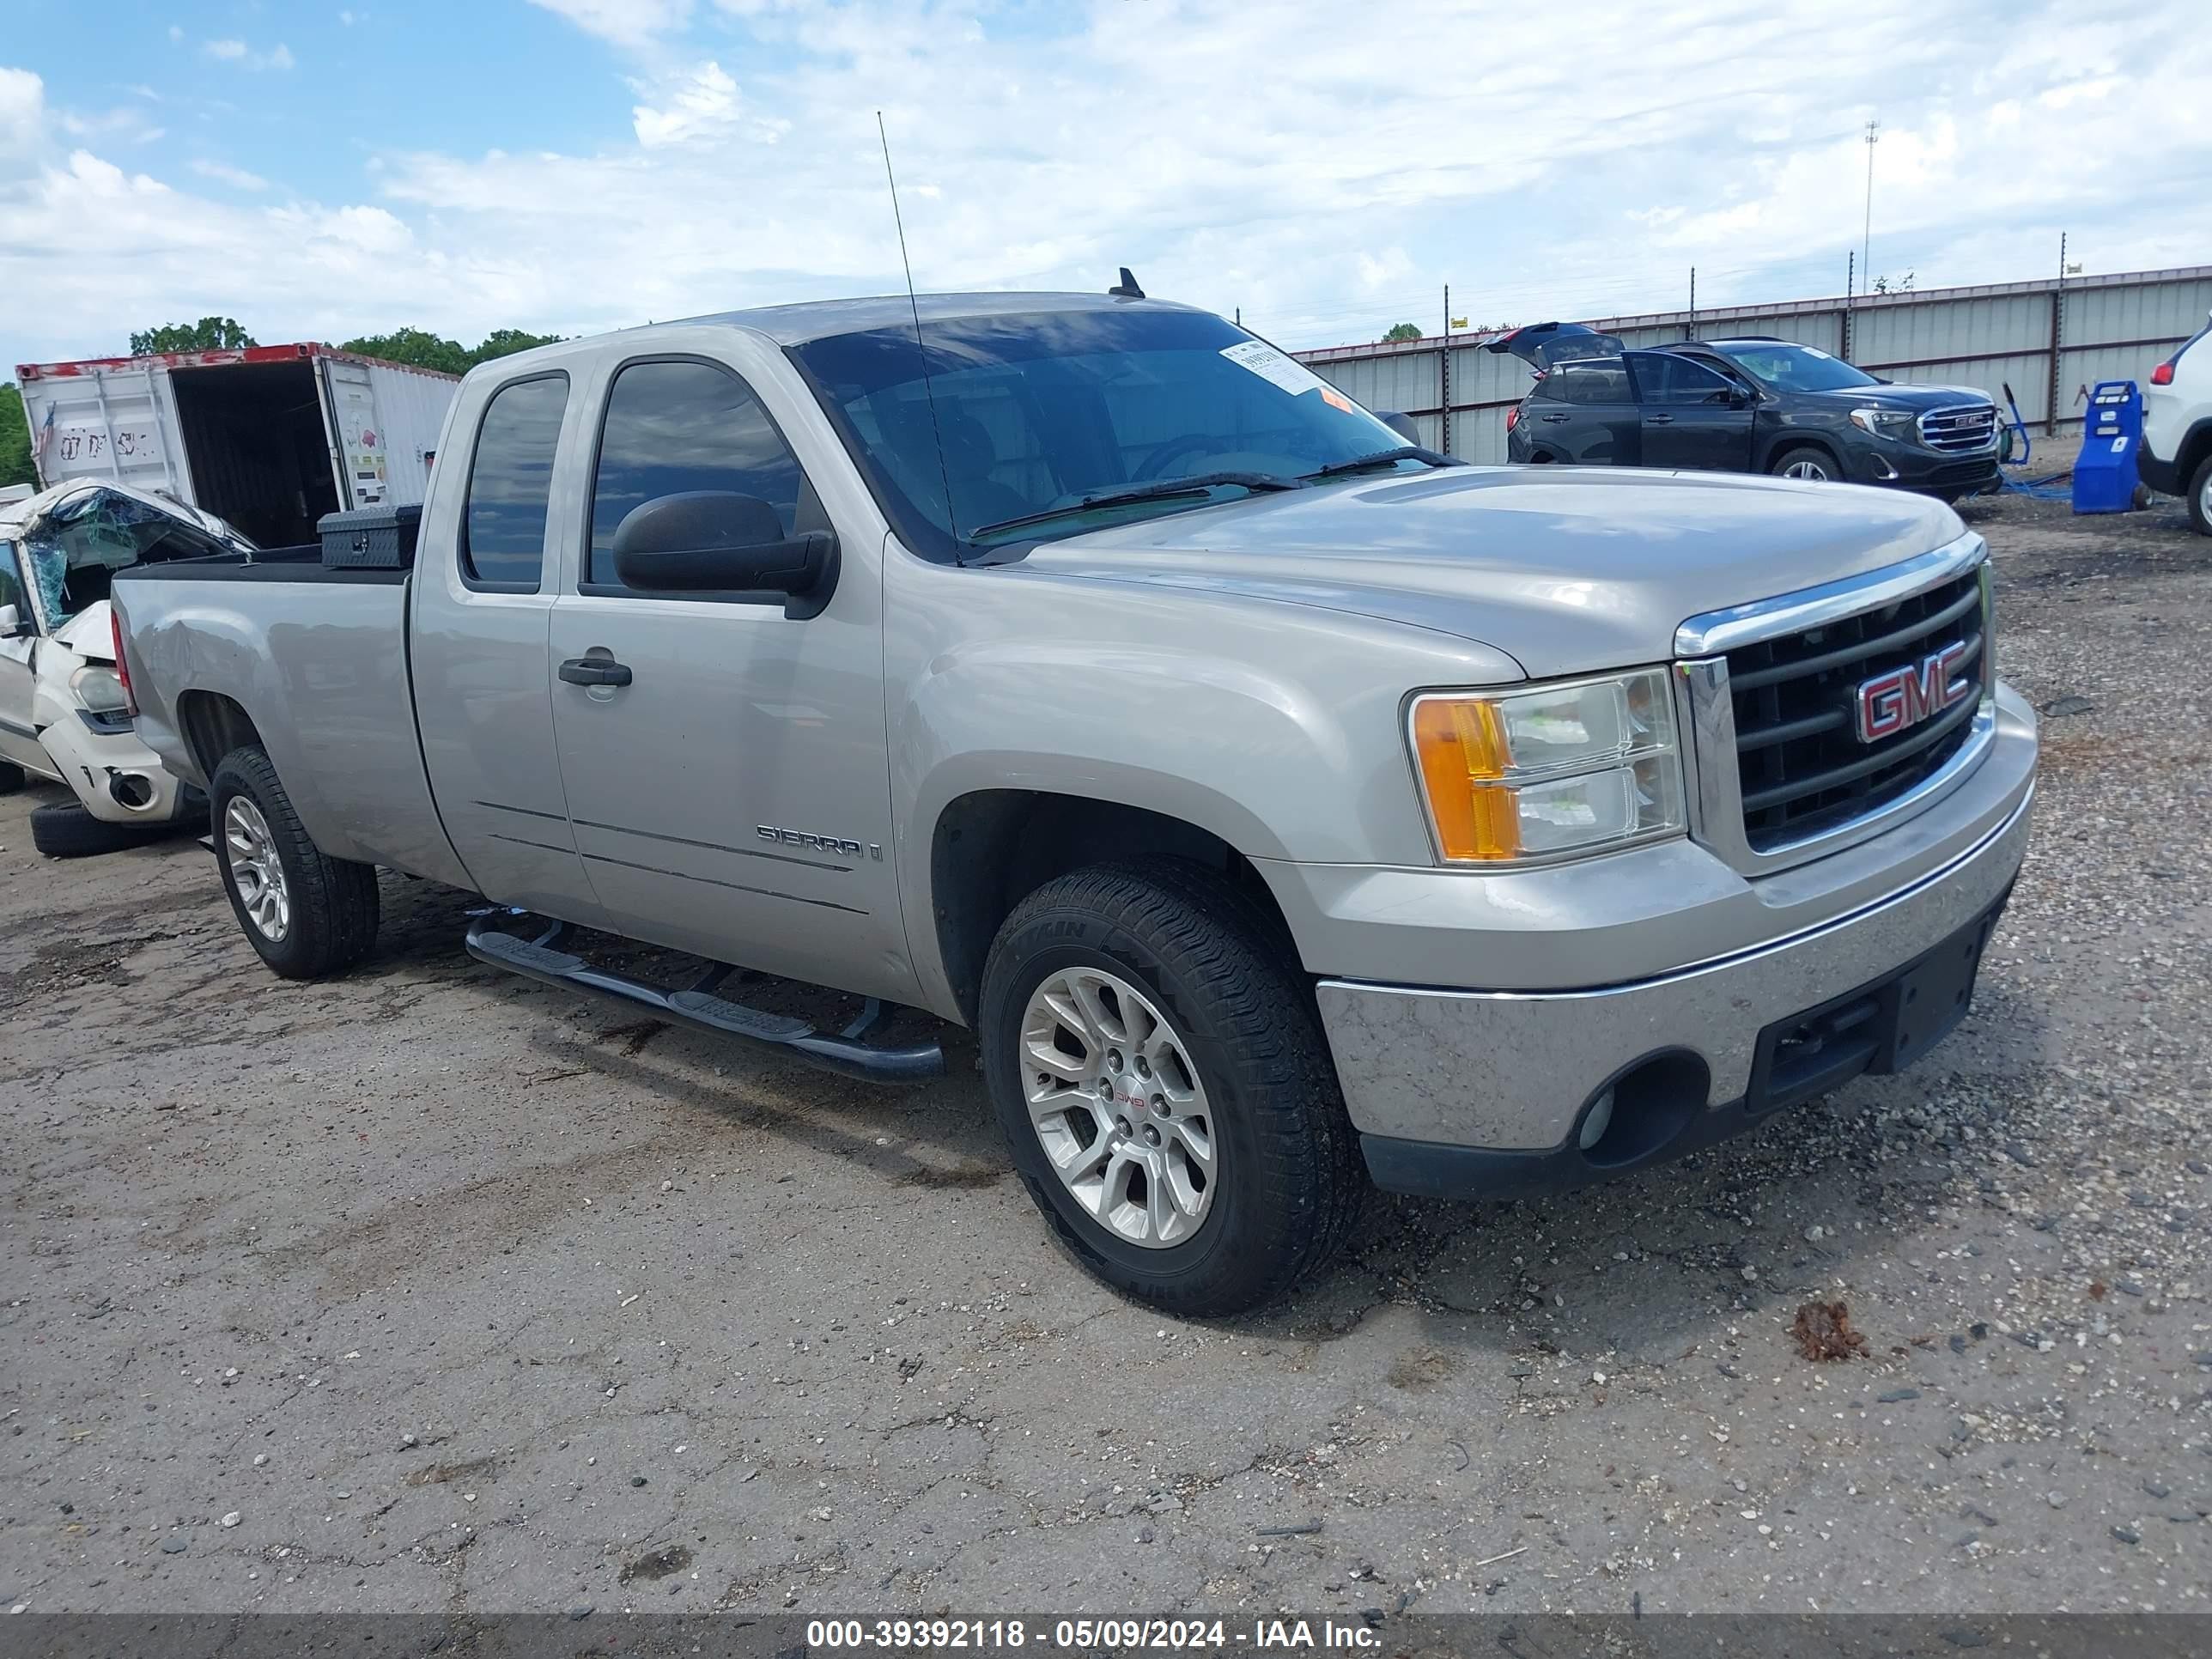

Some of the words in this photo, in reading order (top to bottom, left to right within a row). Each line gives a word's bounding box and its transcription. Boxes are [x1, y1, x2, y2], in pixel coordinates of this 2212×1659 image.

[1856, 640, 1968, 744] GMC
[756, 823, 864, 858] SIERRA
[1116, 1091, 1145, 1108] GMC
